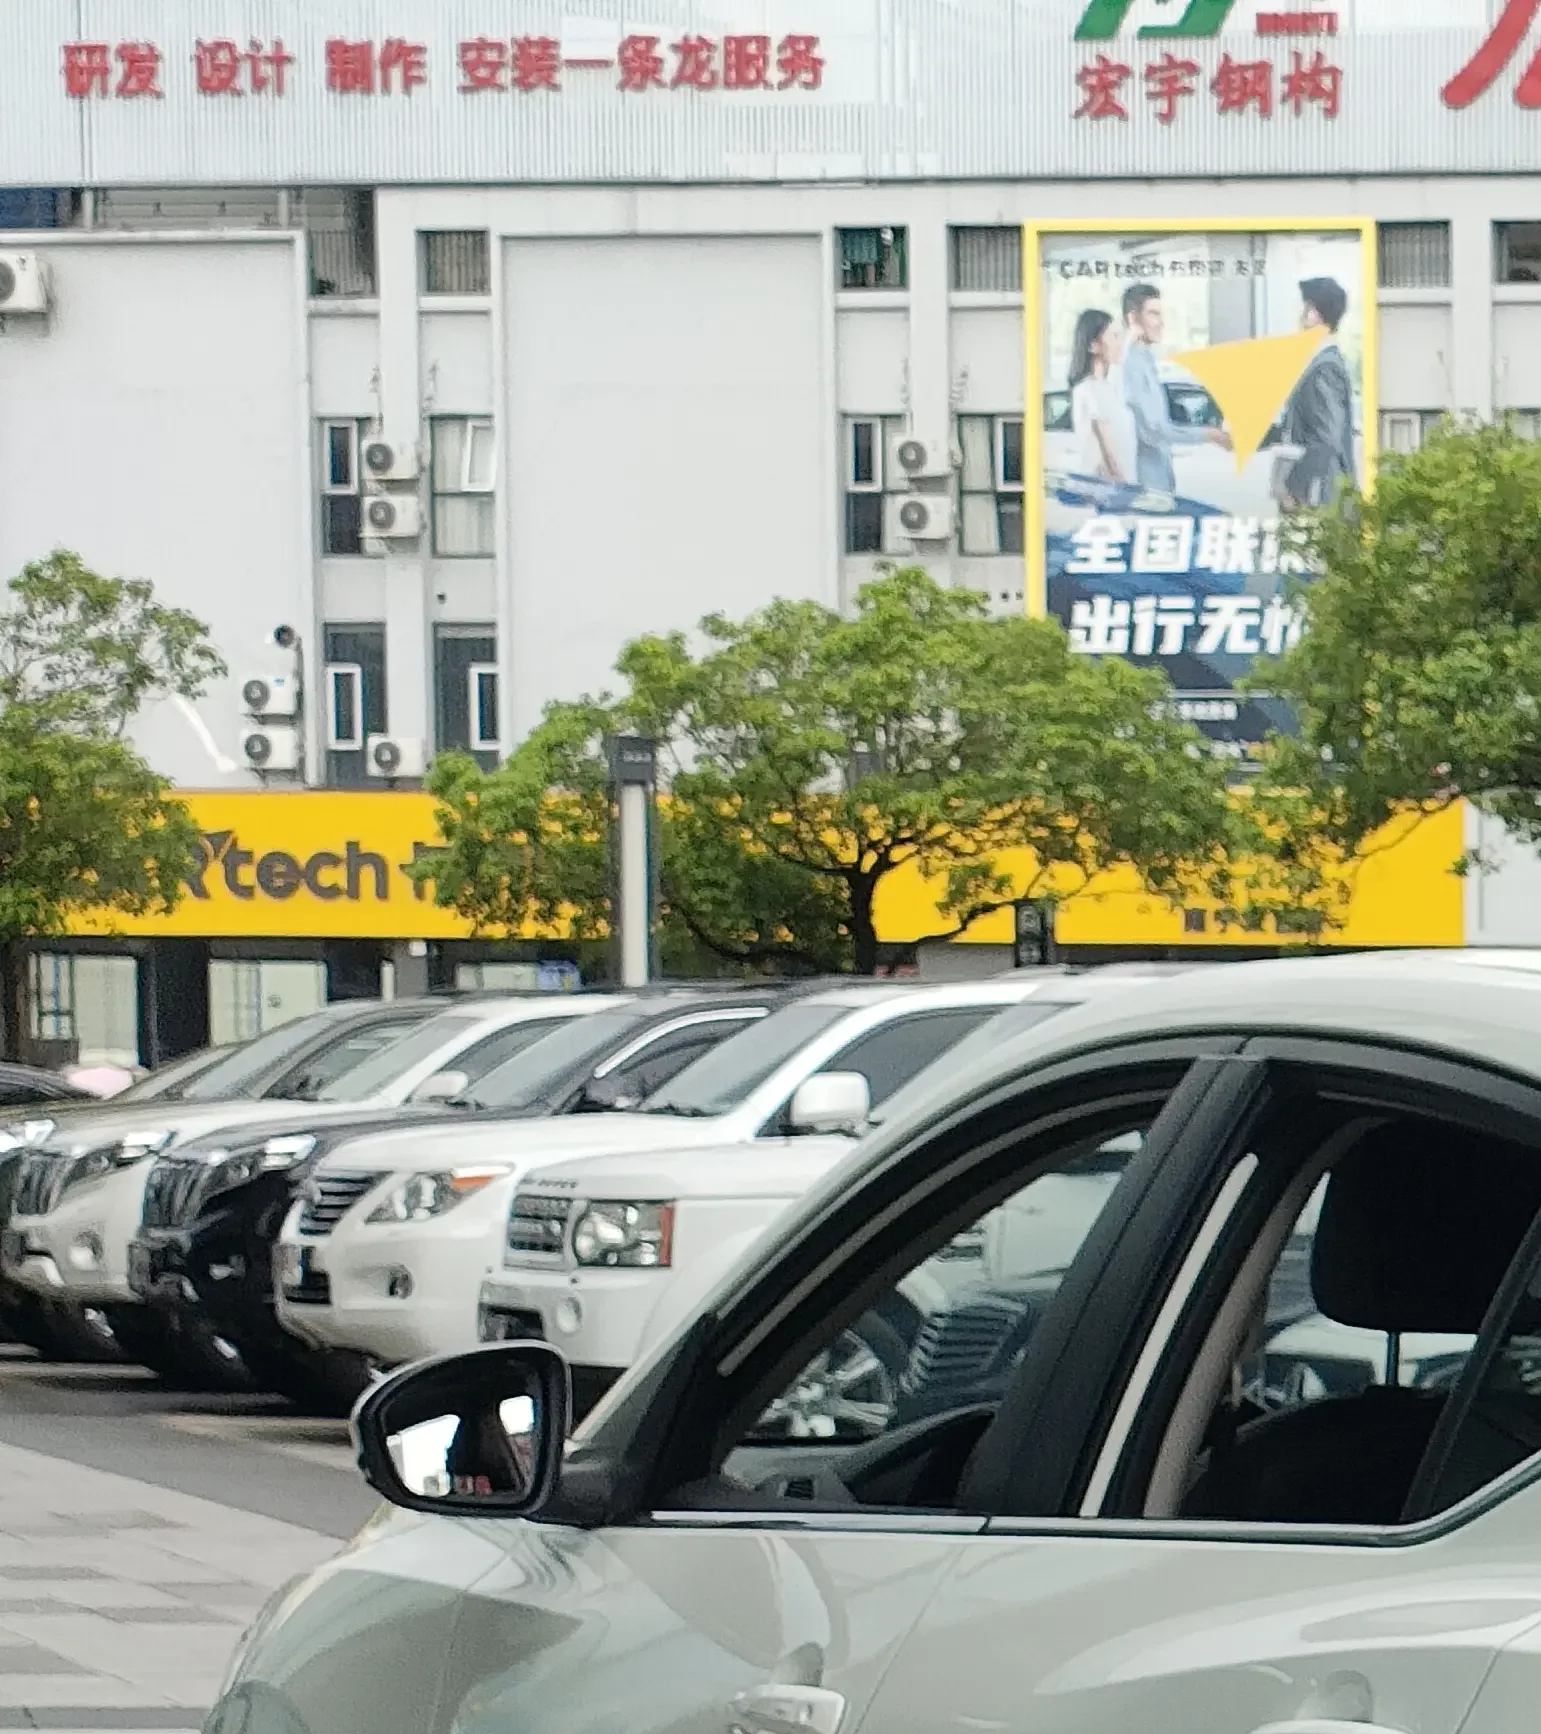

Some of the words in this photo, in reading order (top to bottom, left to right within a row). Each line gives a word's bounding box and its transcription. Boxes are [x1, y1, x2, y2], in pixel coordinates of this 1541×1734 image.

[63, 42, 164, 98] 研发
[194, 40, 293, 97] 设计
[325, 38, 429, 95] 制作
[457, 34, 825, 93] 安装一条龙服务
[1072, 50, 1344, 125] 宏宇钢构
